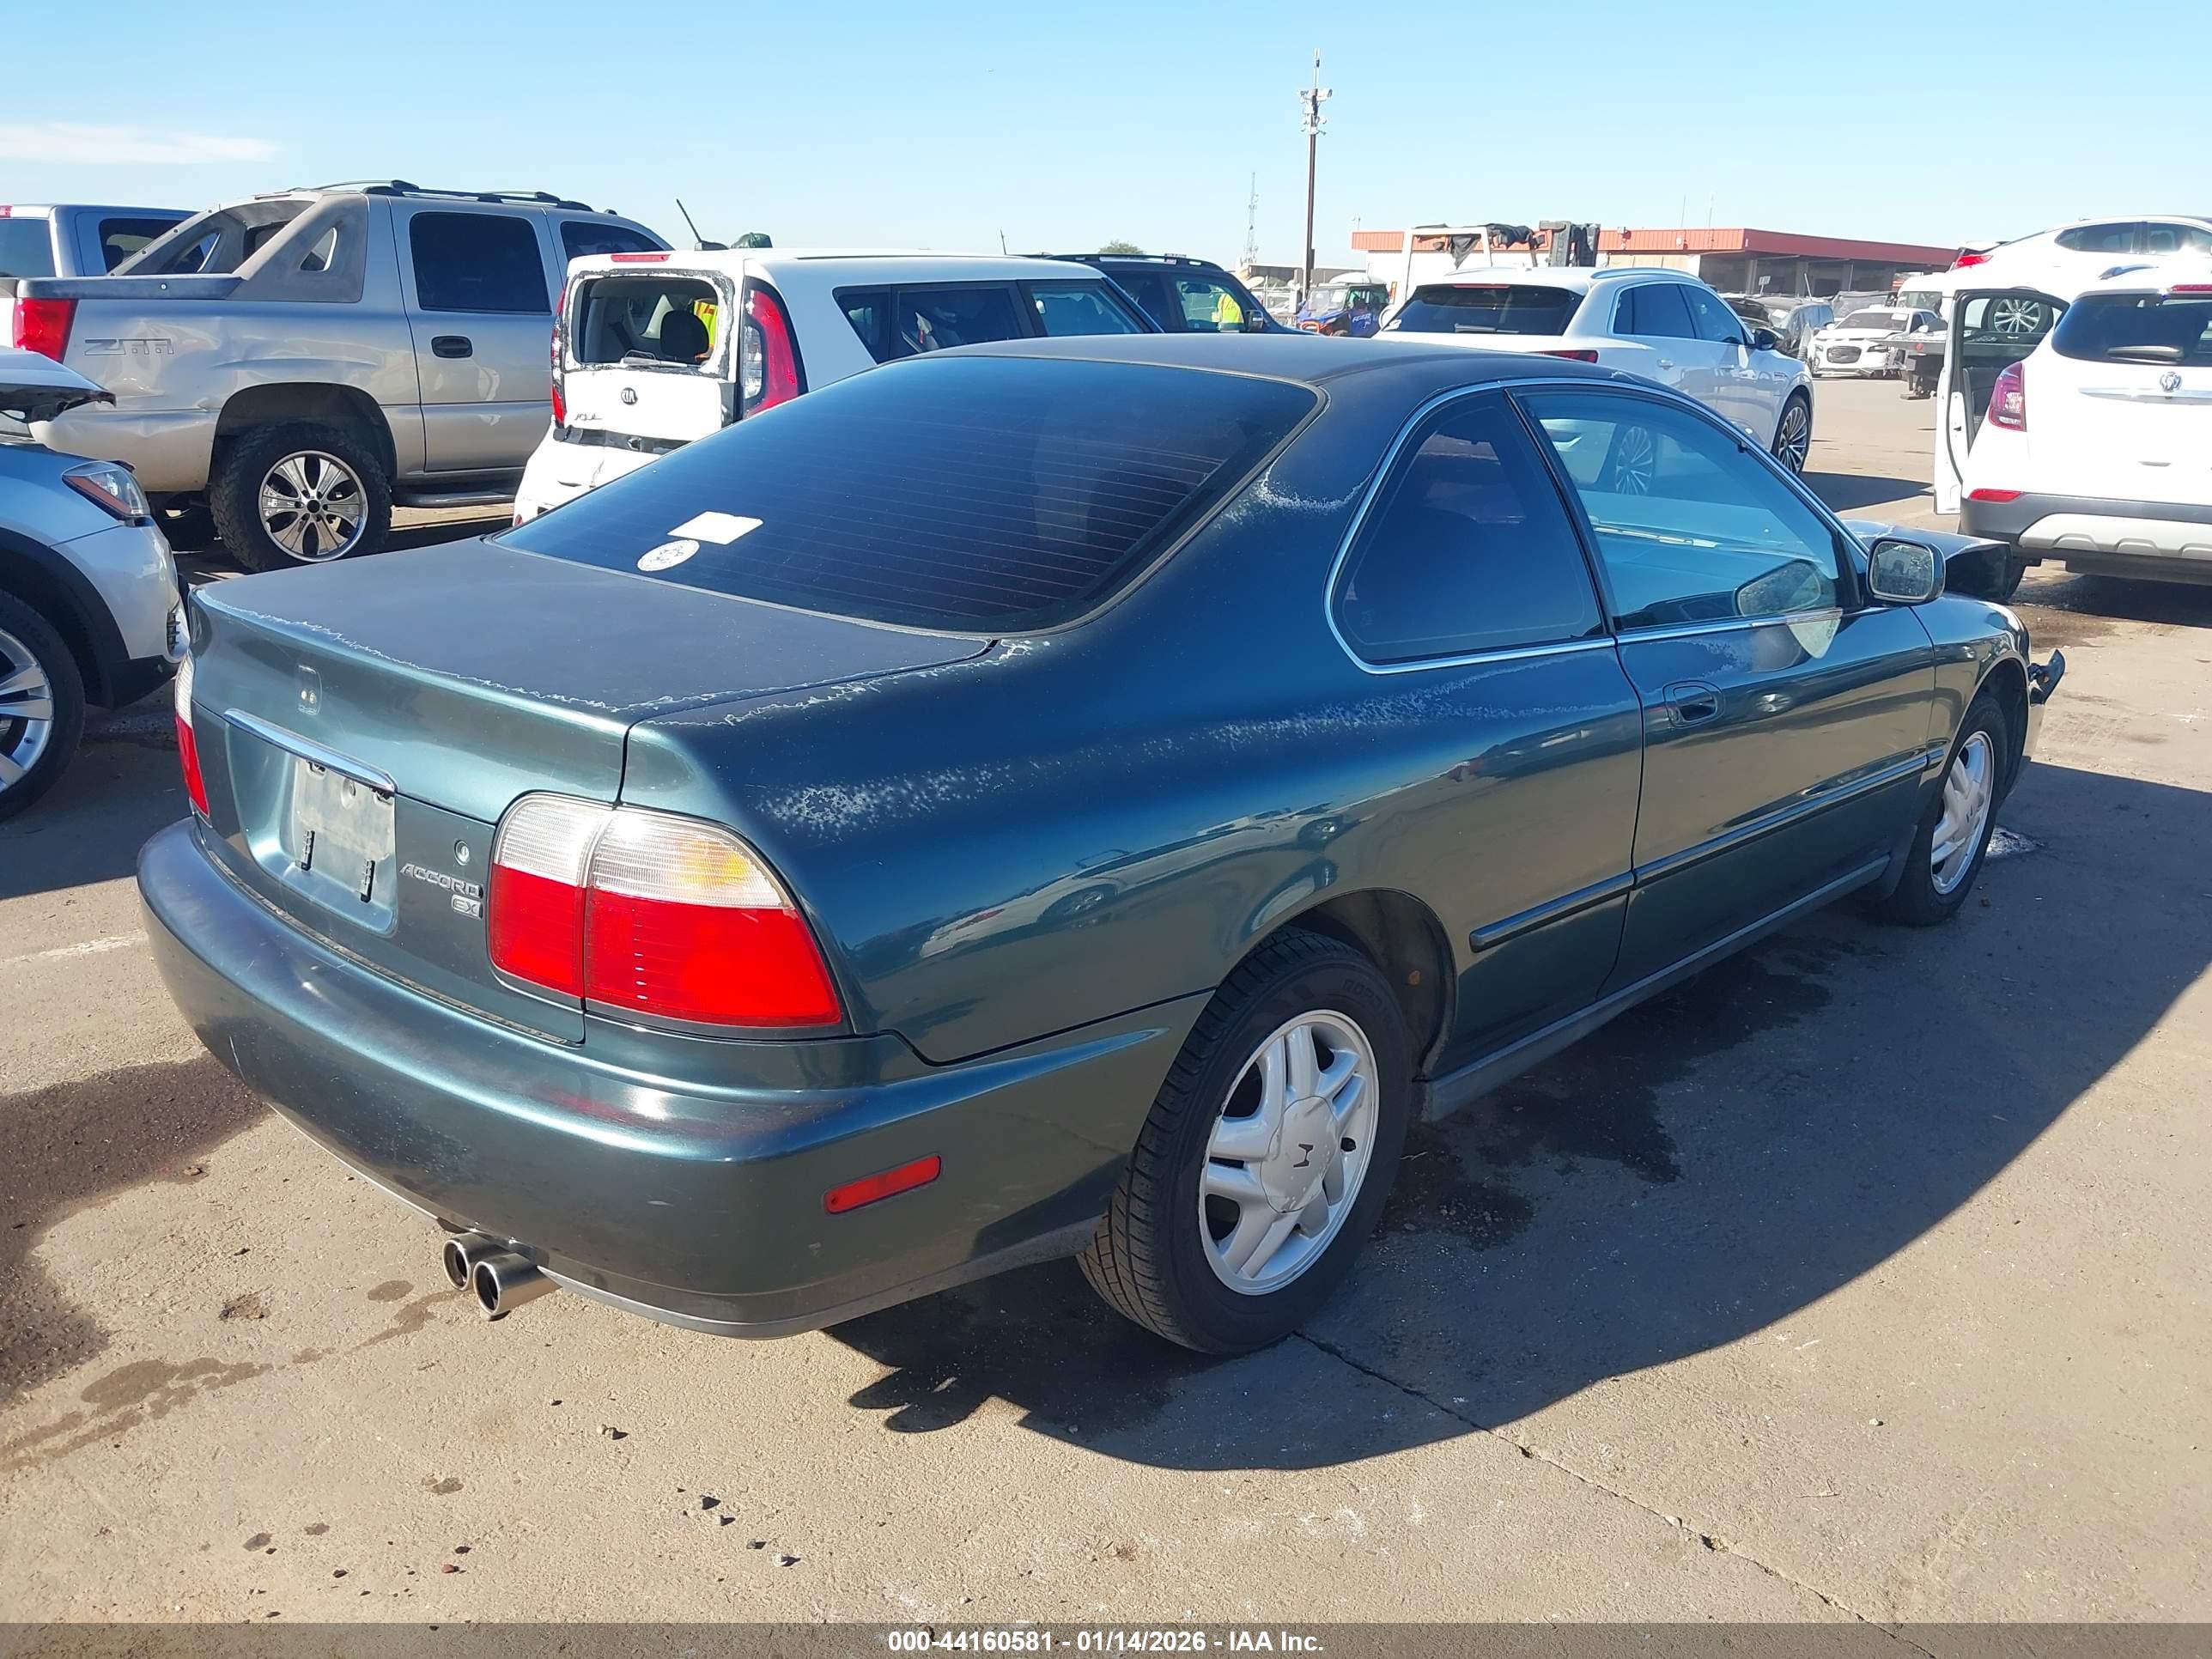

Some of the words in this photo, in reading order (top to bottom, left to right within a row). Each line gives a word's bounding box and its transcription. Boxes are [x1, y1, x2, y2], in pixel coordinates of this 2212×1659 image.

[622, 388, 637, 404] KIA
[399, 863, 483, 899] ACCORD
[452, 895, 483, 920] EX
